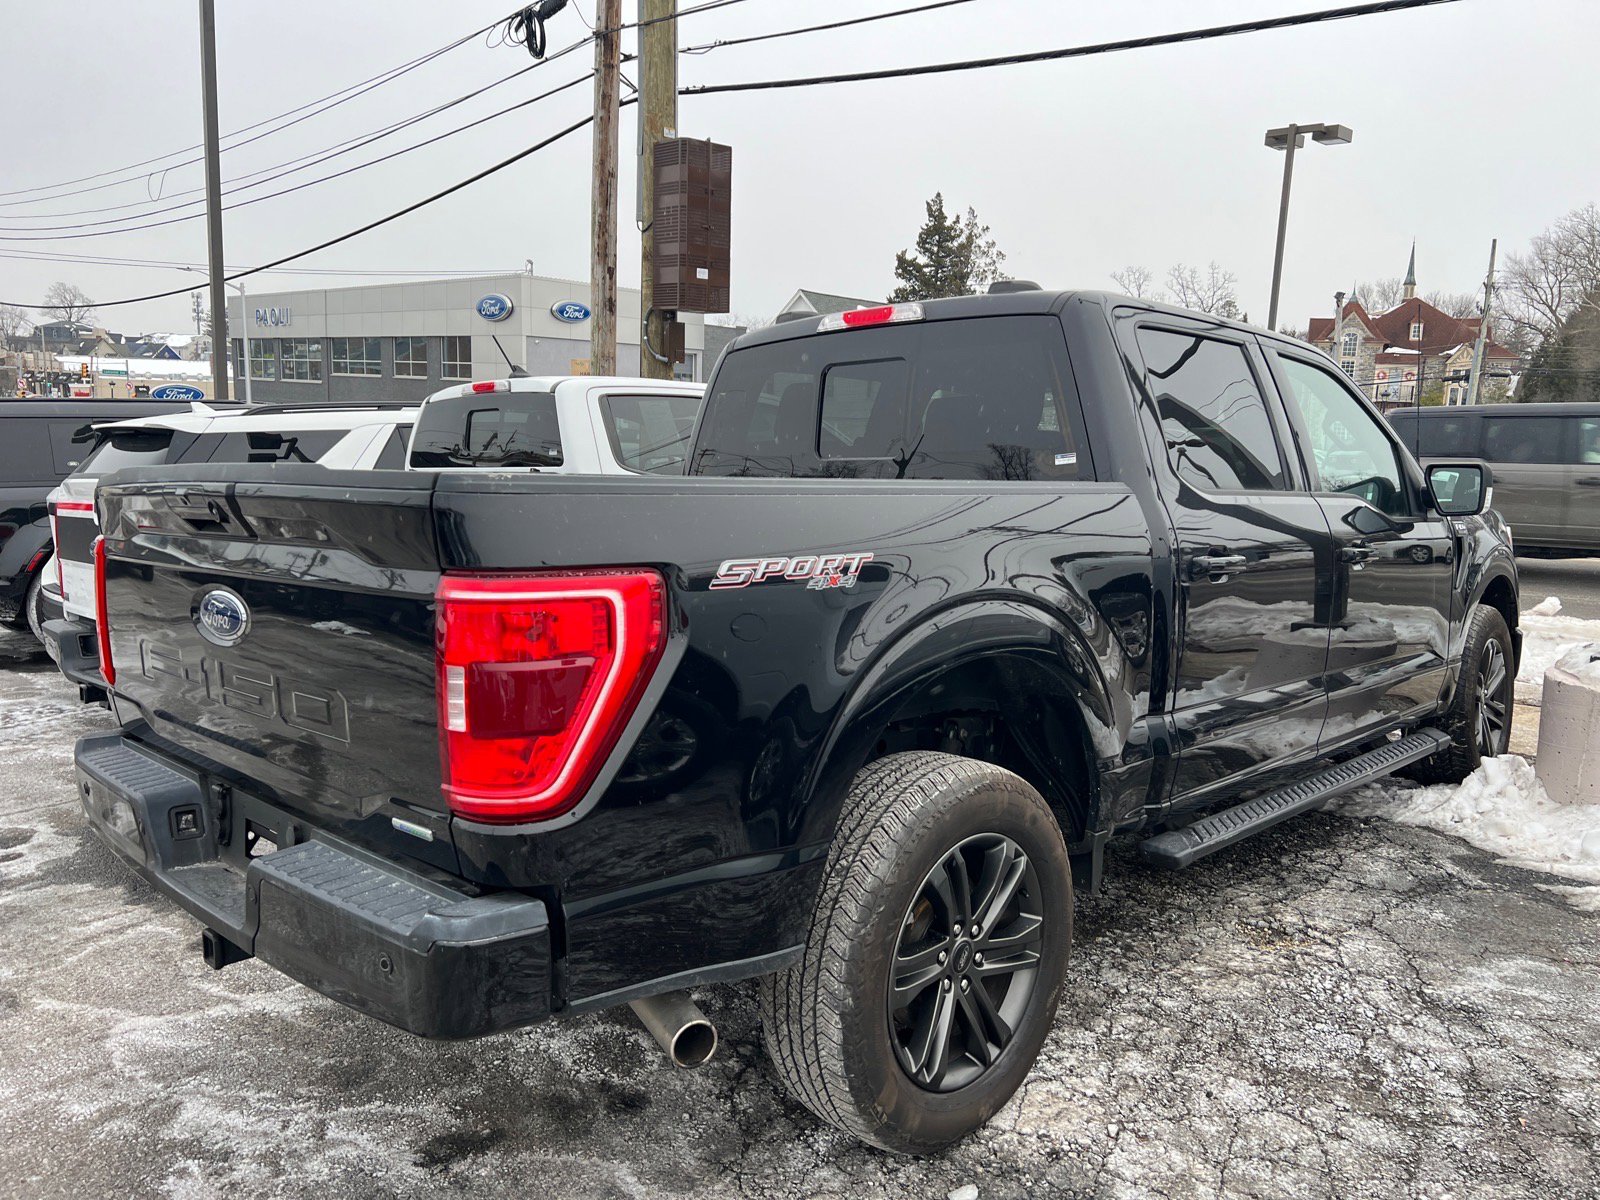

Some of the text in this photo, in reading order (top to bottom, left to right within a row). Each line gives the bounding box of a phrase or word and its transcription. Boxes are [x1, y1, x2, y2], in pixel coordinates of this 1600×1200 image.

[481, 299, 500, 315] Ford
[564, 304, 585, 319] Ford
[255, 307, 290, 325] PAOLI
[163, 387, 194, 400] Ford
[709, 552, 874, 590] SPORT
[204, 599, 232, 630] Ford
